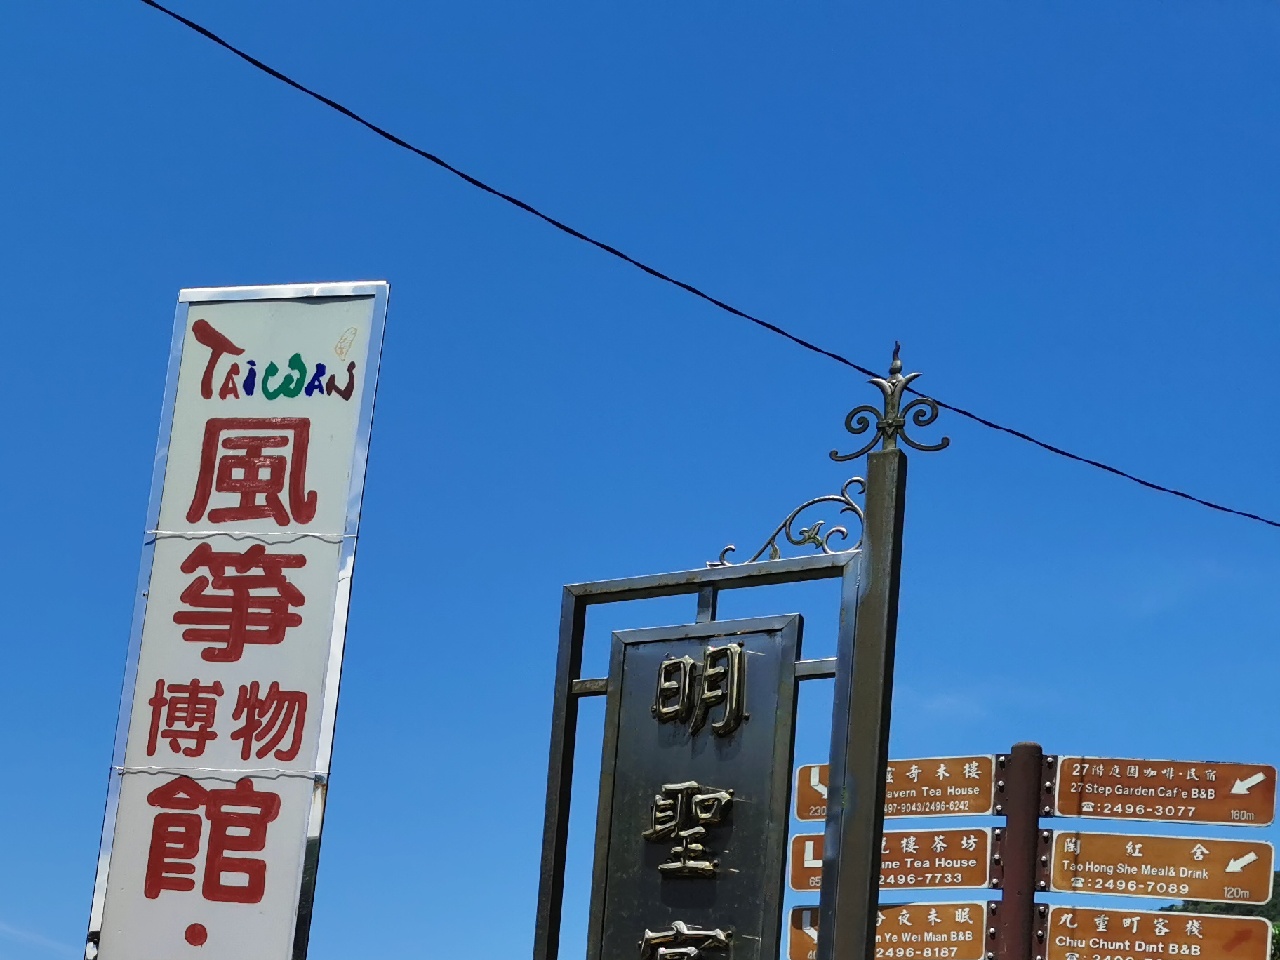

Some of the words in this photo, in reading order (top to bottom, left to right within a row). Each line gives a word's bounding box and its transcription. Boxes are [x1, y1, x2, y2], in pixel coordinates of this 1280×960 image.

[921, 786, 942, 797] Tea
[947, 786, 980, 797] House
[1071, 783, 1083, 793] 27
[1085, 784, 1113, 796] Step
[1115, 785, 1155, 797] Garden
[1191, 789, 1215, 801] B&B
[905, 859, 930, 869] Tea
[935, 857, 977, 868] House
[1062, 861, 1083, 873] Tao
[1085, 862, 1114, 876] Hong
[1116, 863, 1138, 875] She
[1180, 867, 1209, 879] Drink
[879, 873, 963, 885] 2496-7733
[1224, 887, 1249, 899] 120m
[884, 932, 898, 943] Ye
[901, 931, 921, 943] Wei
[923, 931, 948, 943] Mian
[950, 930, 973, 942] B&B
[876, 946, 959, 958] 2496-8187
[1055, 936, 1086, 948] Chiu
[1168, 943, 1201, 956] B&B
